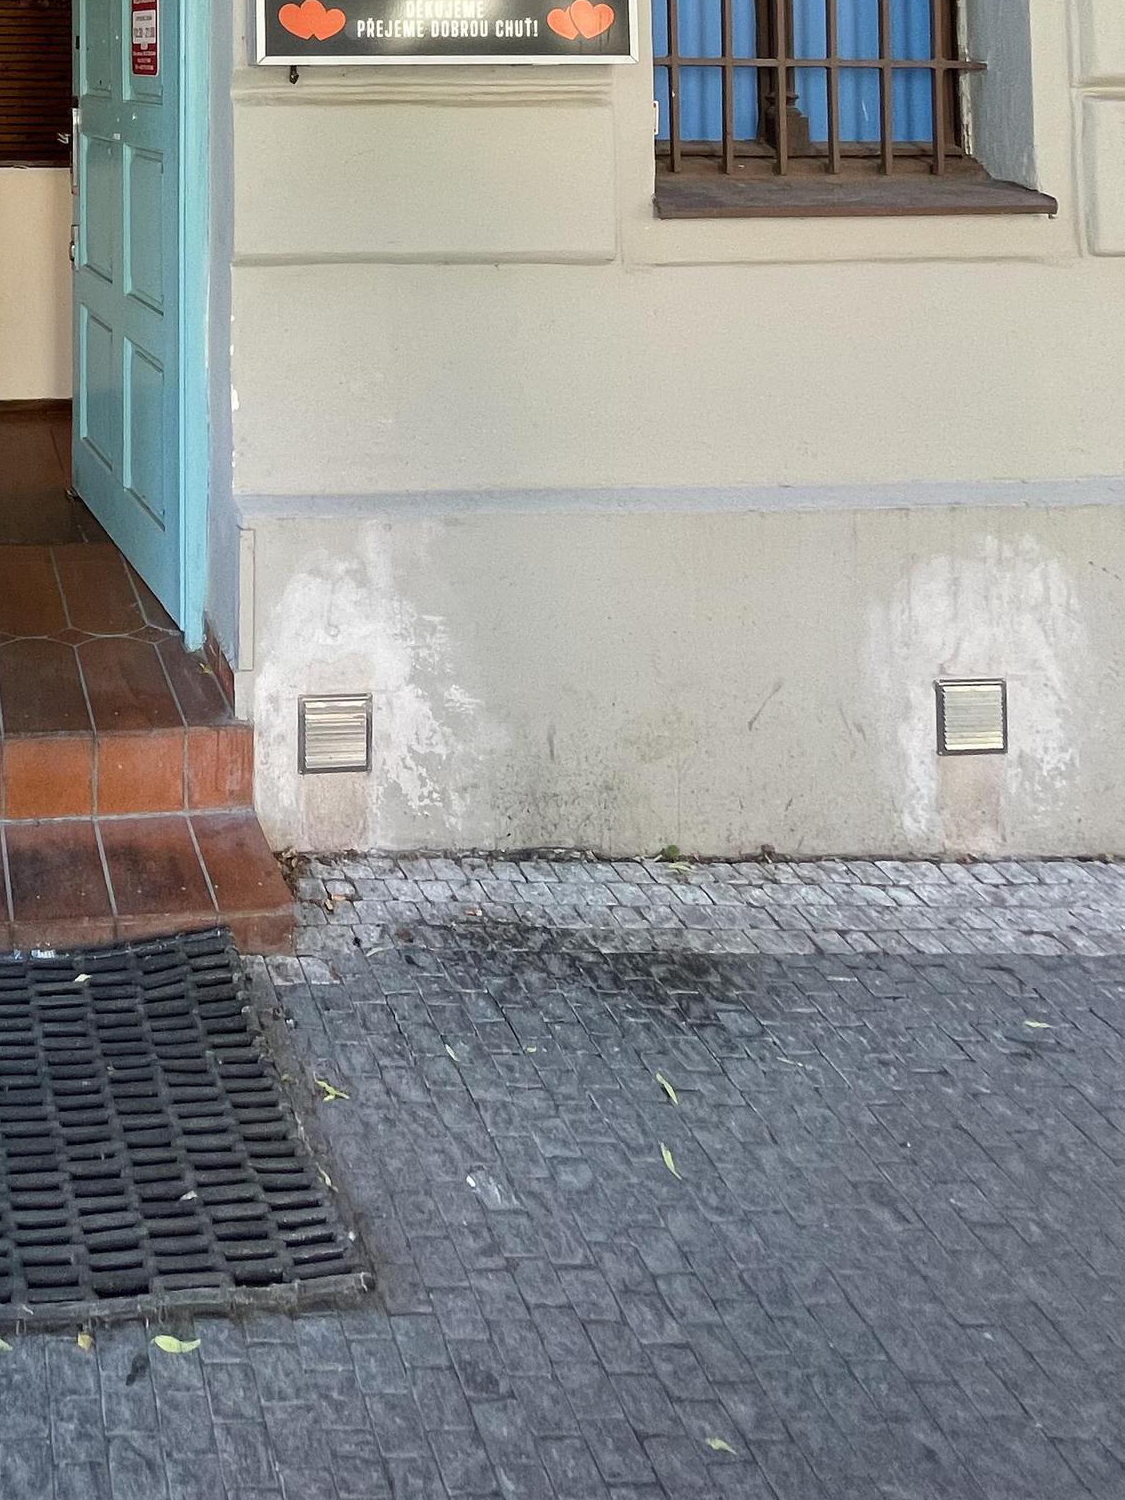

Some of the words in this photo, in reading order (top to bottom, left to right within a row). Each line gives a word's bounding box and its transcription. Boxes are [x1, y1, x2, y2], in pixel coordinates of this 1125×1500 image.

[357, 17, 425, 38] PŘEJEME
[431, 19, 489, 38] DOBROU
[495, 17, 539, 38] CHUŤ!
